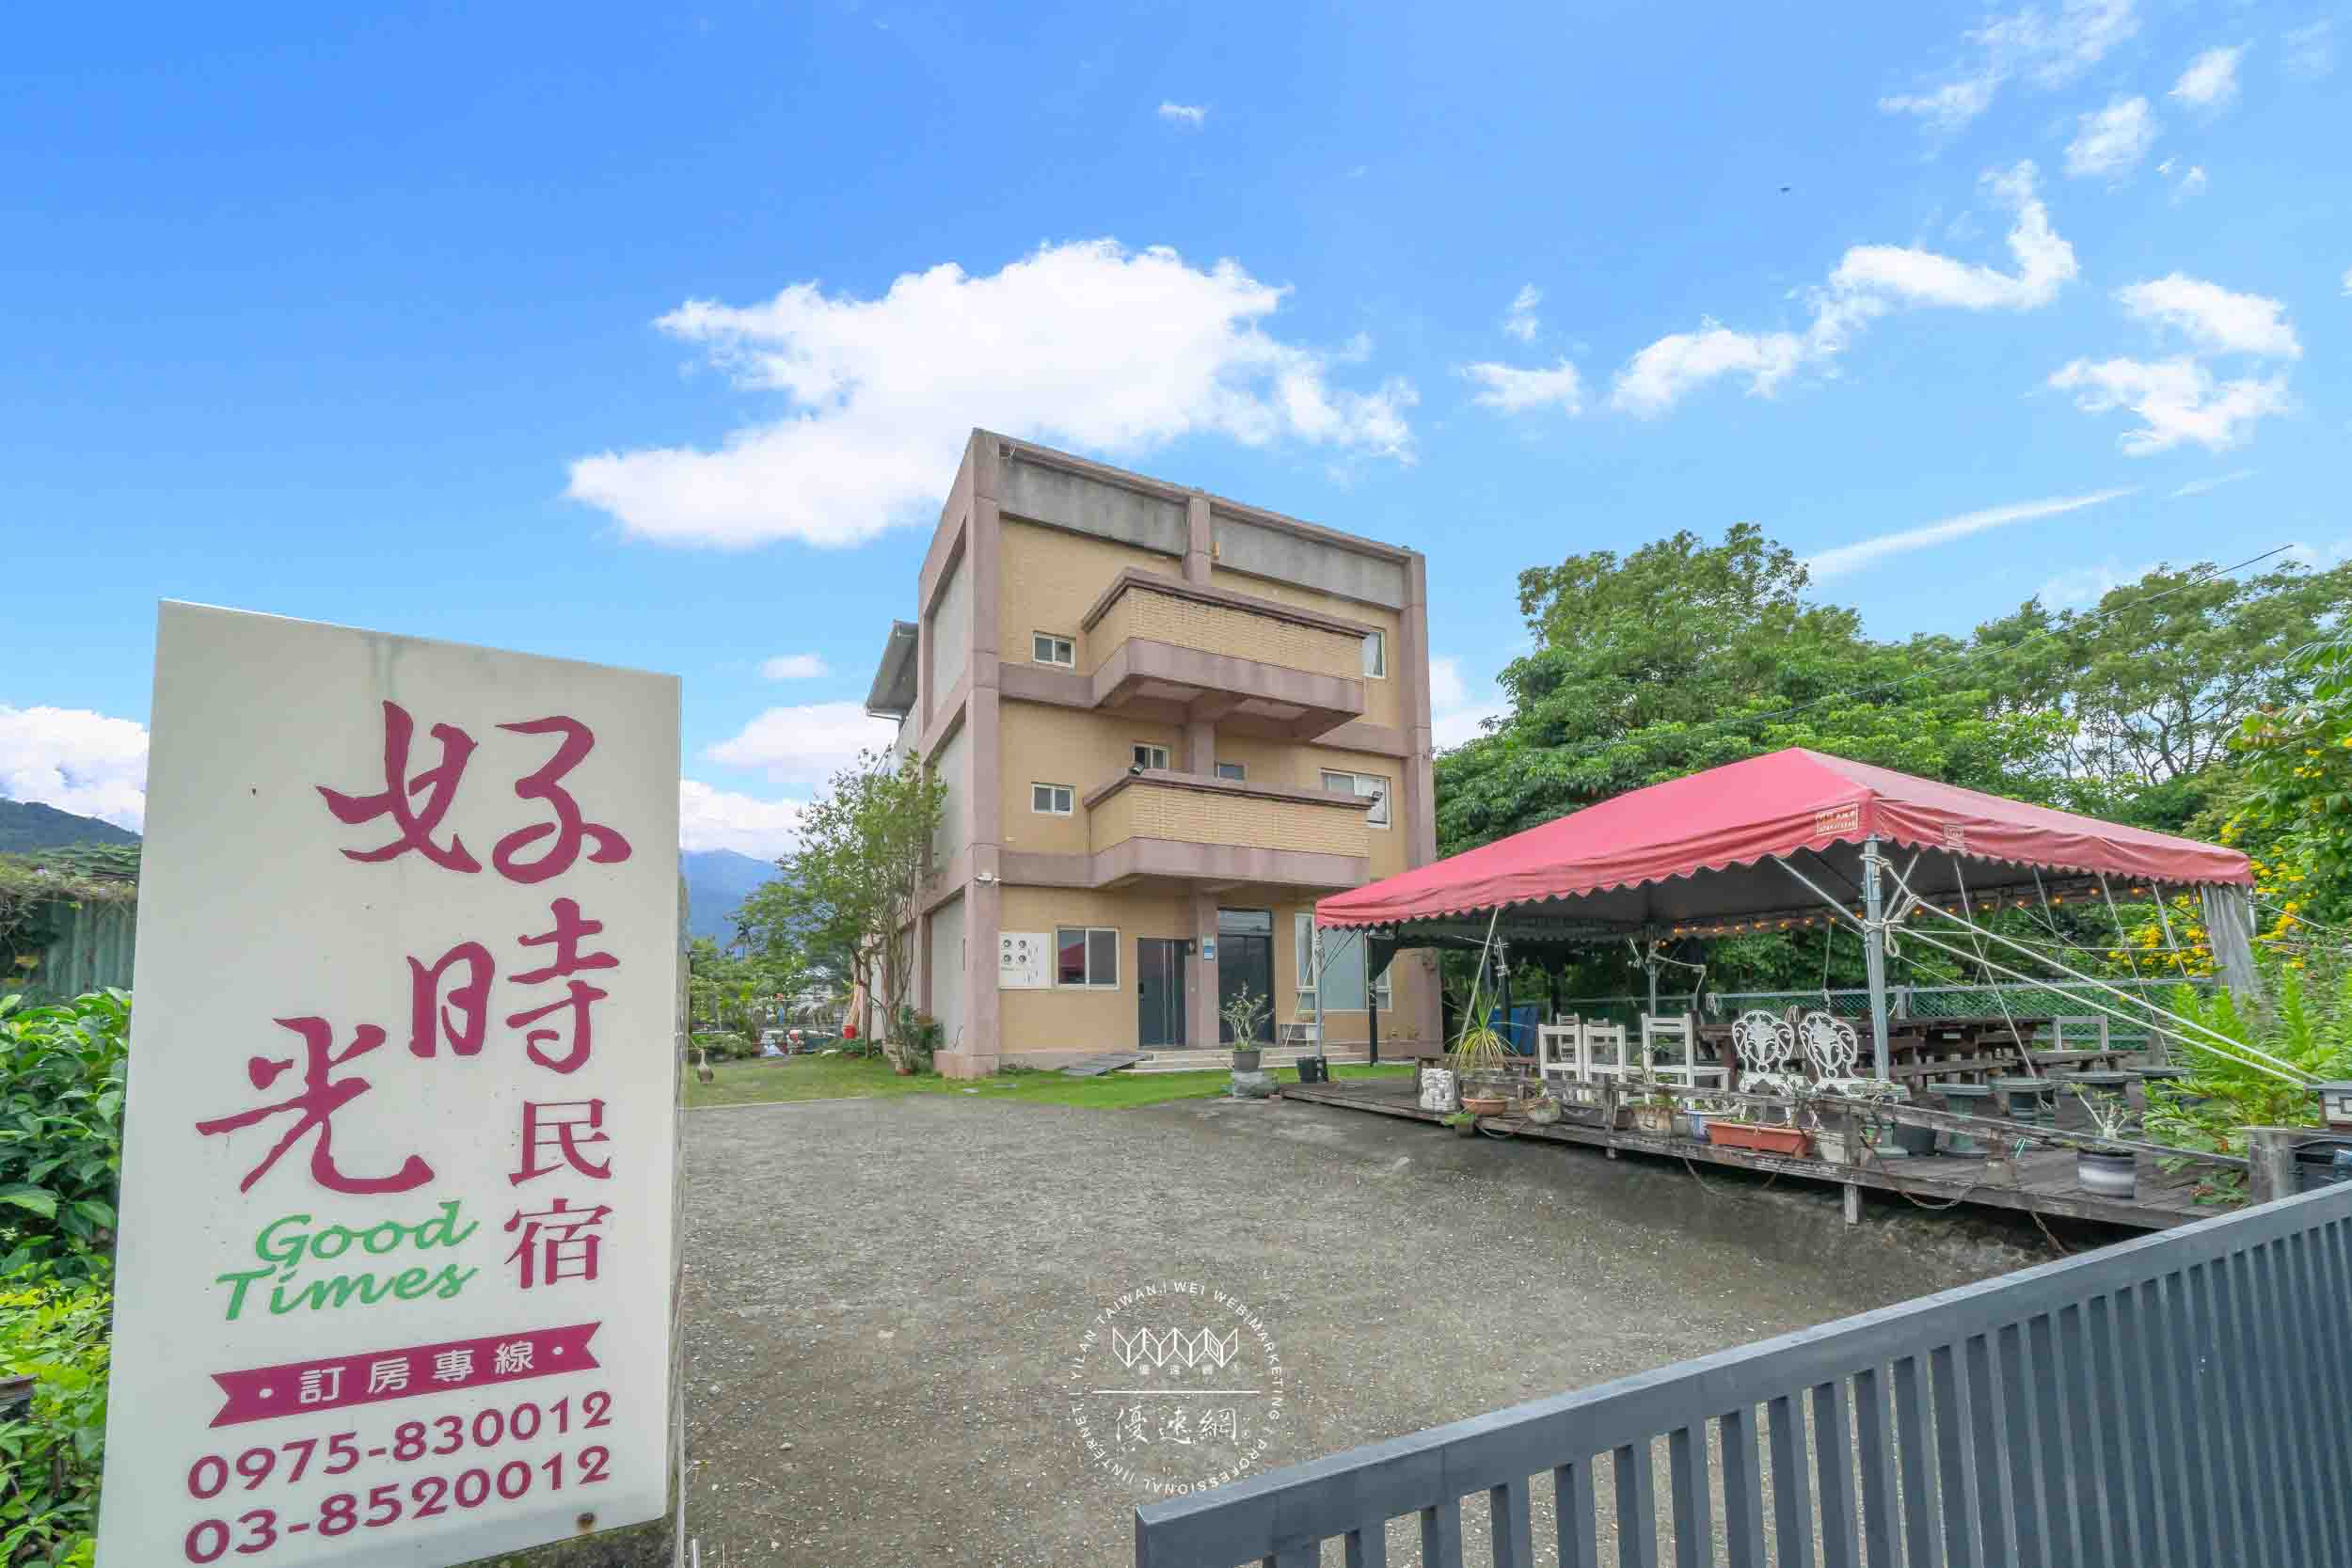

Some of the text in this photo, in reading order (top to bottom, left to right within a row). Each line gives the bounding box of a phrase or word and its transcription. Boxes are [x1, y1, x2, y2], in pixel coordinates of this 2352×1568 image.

[254, 1200, 478, 1267] Good
[504, 1099, 612, 1290] 民宿
[215, 1263, 478, 1321] Times
[299, 1339, 535, 1404] 訂房專線
[186, 1390, 612, 1500] 0975-830012
[184, 1445, 610, 1565] 03-8520012
